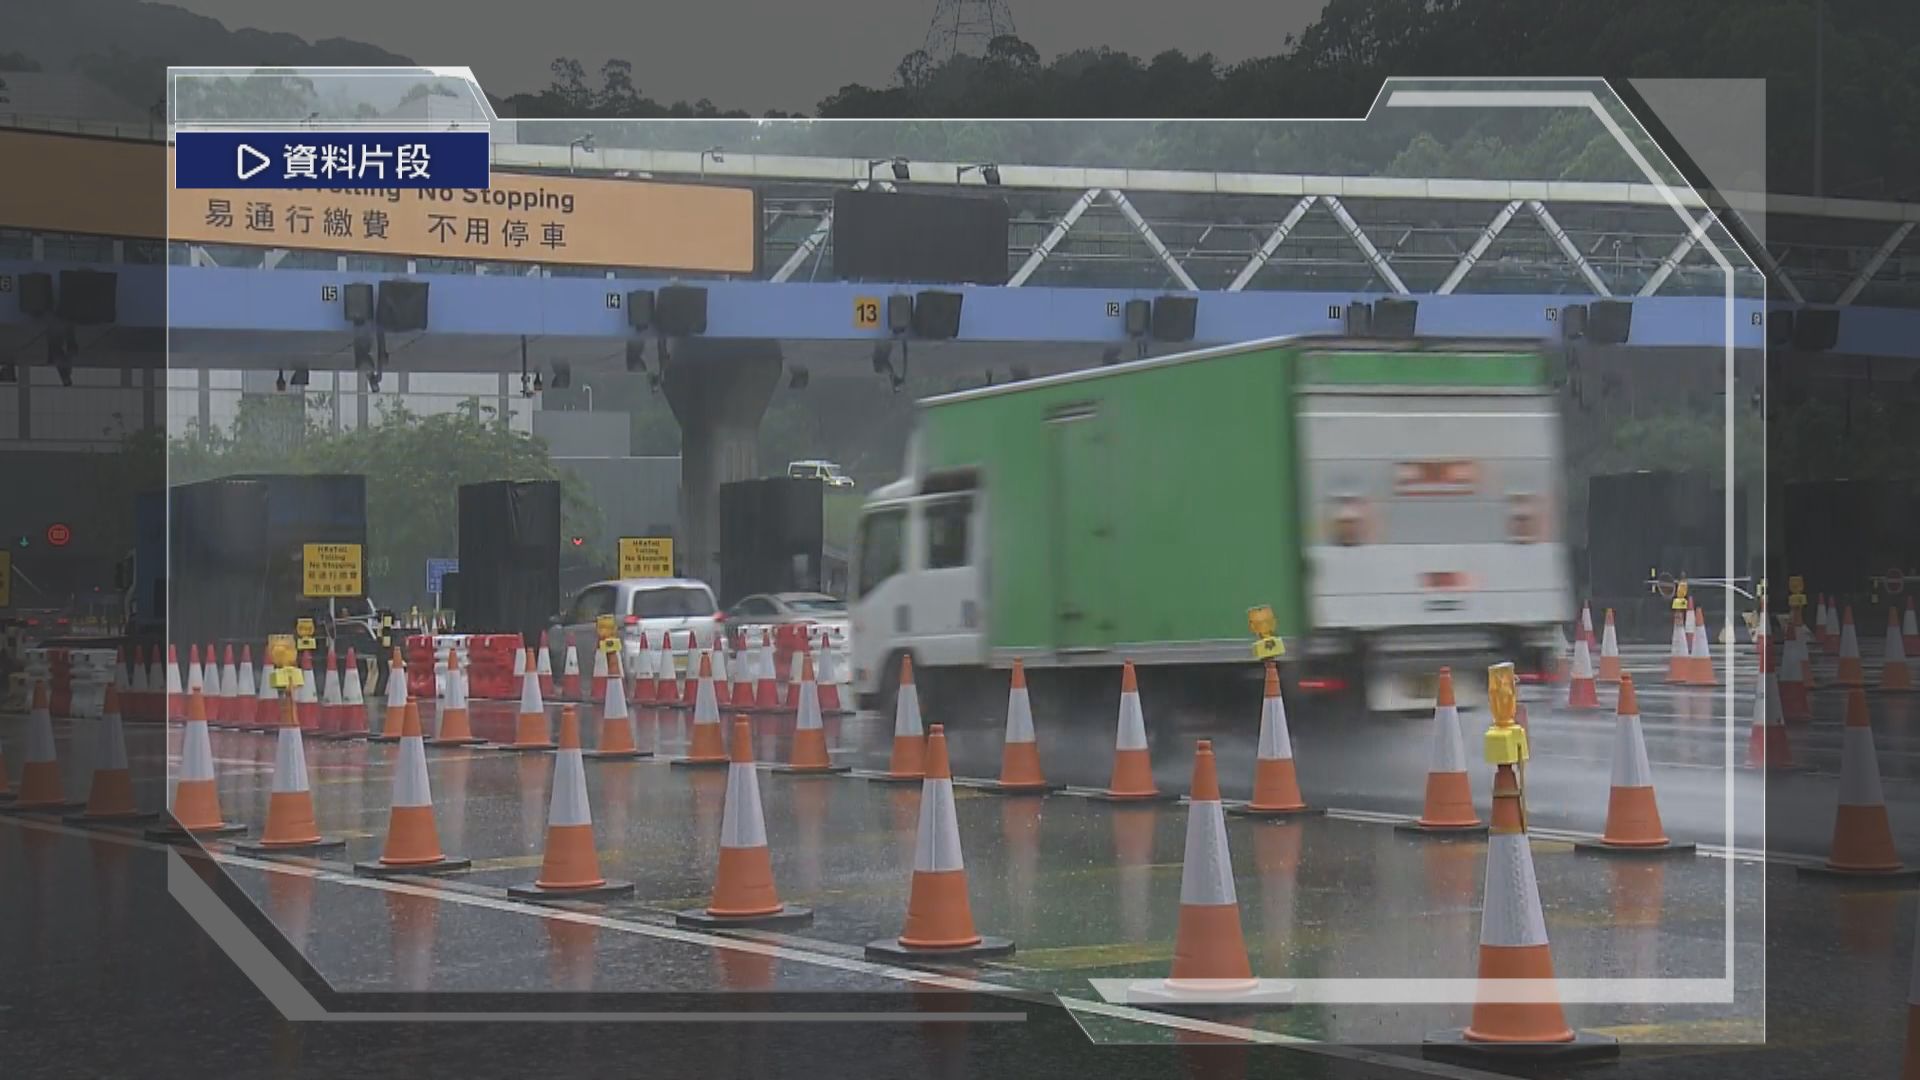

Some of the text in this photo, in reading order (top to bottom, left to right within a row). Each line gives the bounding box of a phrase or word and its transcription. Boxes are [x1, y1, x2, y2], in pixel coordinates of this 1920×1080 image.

[418, 188, 454, 202] No
[462, 188, 574, 213] Stopping
[205, 199, 567, 250] 易通行繳費 不用停車
[323, 286, 337, 300] 15
[856, 303, 877, 323] 13
